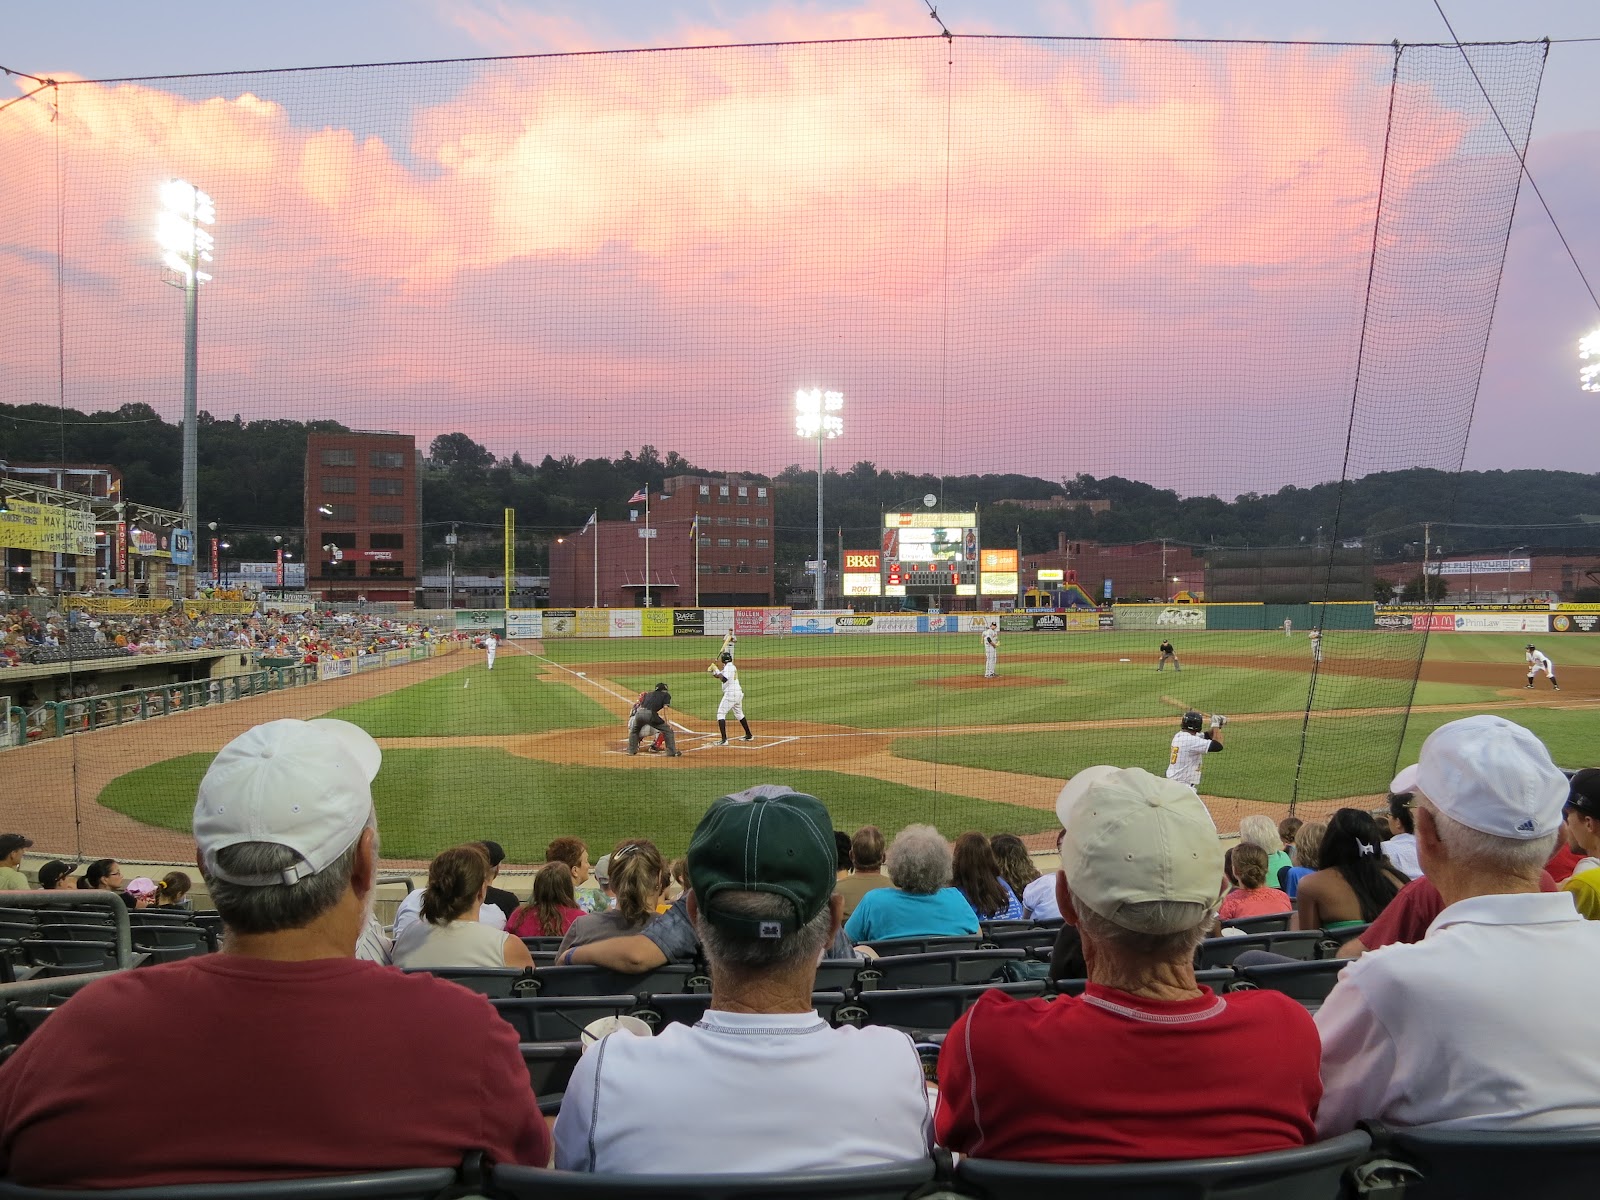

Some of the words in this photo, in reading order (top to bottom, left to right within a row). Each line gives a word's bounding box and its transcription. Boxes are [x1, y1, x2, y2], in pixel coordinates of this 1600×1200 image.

[43, 516, 61, 529] MAY
[67, 520, 96, 532] AUGUST
[41, 533, 54, 543] LIVE
[56, 532, 73, 542] MUSIC
[83, 546, 96, 555] BEER
[845, 555, 879, 568] BB&T
[1453, 560, 1509, 570] FURNITURE
[837, 617, 872, 626] SUBWAY
[1037, 615, 1064, 625] ADELPHIA
[1465, 618, 1500, 628] PrimLaw
